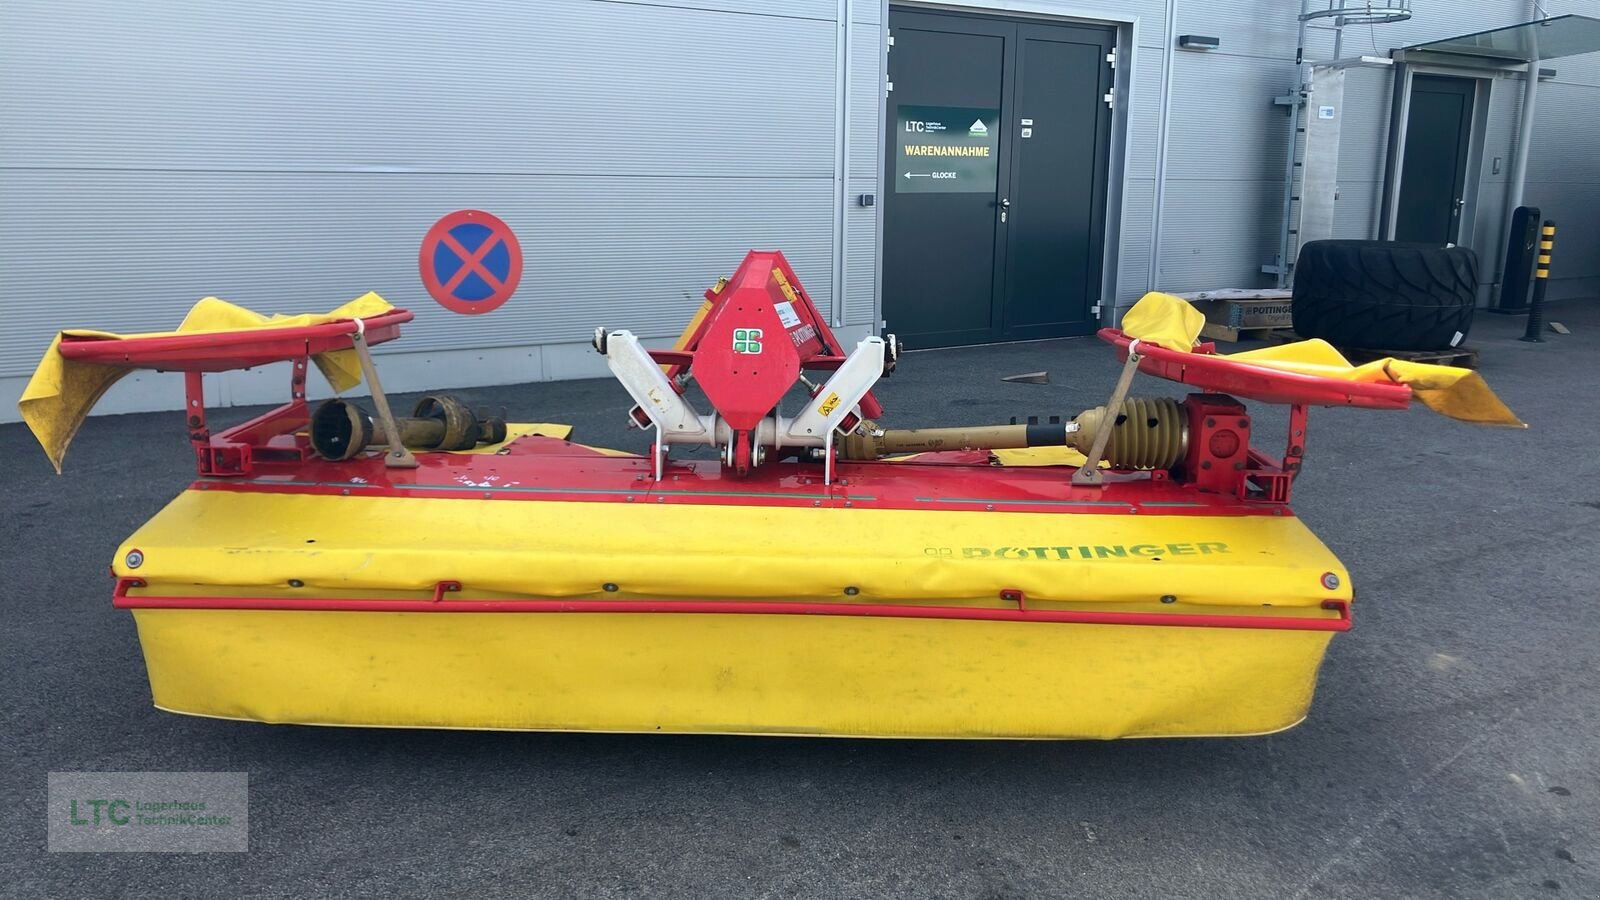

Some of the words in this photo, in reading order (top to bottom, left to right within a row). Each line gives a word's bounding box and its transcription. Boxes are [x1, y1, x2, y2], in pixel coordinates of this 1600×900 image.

[905, 120, 925, 133] LTC
[904, 145, 990, 157] WARENANNAHME
[931, 171, 957, 179] GLOCKE
